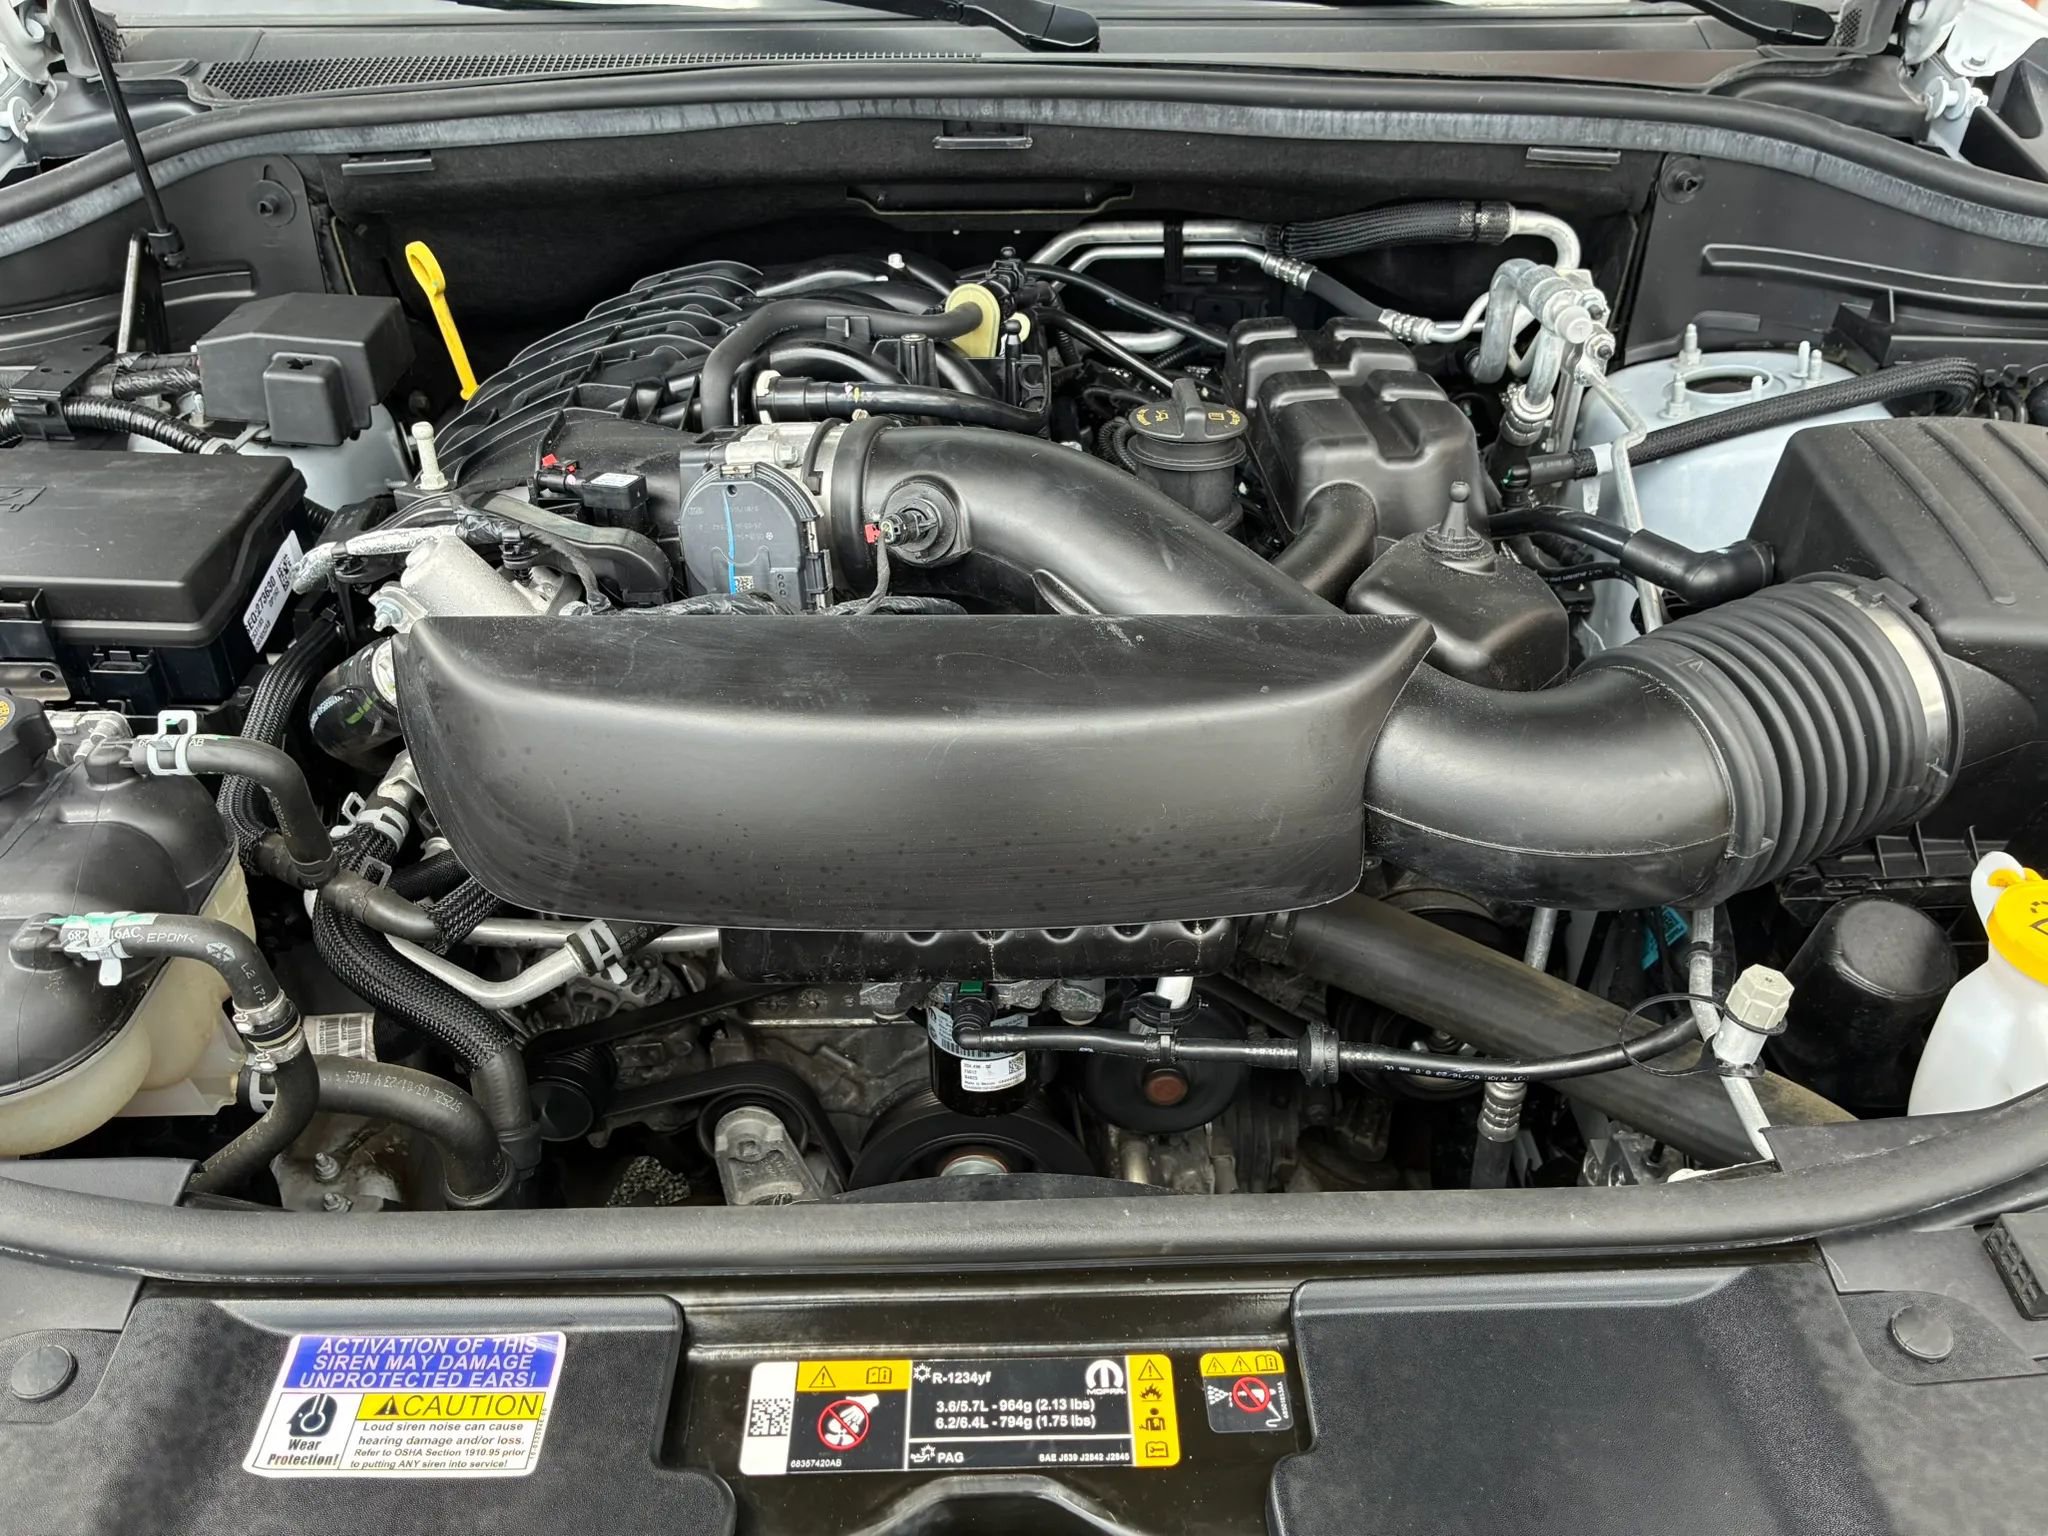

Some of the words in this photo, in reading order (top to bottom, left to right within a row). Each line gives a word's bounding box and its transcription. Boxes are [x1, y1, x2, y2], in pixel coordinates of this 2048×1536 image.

[317, 1337, 449, 1354] ACTIVATION
[455, 1337, 485, 1354] OF
[491, 1335, 539, 1353] THIS
[313, 1355, 379, 1370] SIREN
[385, 1354, 434, 1370] MAY
[438, 1354, 534, 1370] DAMAGE
[299, 1371, 463, 1388] UNPROTECTED
[469, 1370, 537, 1388] EARS!
[932, 1371, 992, 1386] R-1234yf
[403, 1394, 540, 1416] CAUTION
[936, 1400, 989, 1413] 3.6/5.7L
[999, 1400, 1032, 1413] 964g
[1035, 1398, 1067, 1413] (2.13
[1070, 1398, 1096, 1412] lbs)
[363, 1422, 394, 1431] Loud
[396, 1422, 426, 1431] siren
[429, 1421, 461, 1431] noise
[464, 1423, 485, 1431] can
[489, 1423, 524, 1431] cause
[935, 1417, 989, 1430] 6.2/6.4L
[1000, 1416, 1032, 1430] 794g
[1035, 1415, 1068, 1430] (1.75
[1071, 1415, 1097, 1429] lbs)
[288, 1438, 322, 1451] Wear
[358, 1435, 403, 1447] hearing
[406, 1435, 453, 1447] damage
[456, 1435, 495, 1445] and/or
[497, 1435, 525, 1445] loss.
[266, 1453, 340, 1466] Protection!
[354, 1448, 380, 1457] Refer
[382, 1448, 392, 1457] to
[394, 1448, 423, 1457] OSHA
[425, 1448, 461, 1457] Section
[464, 1448, 501, 1457] 1910.95
[502, 1447, 527, 1458] prior
[937, 1452, 964, 1463] PAG
[350, 1460, 360, 1468] to
[361, 1460, 397, 1470] putting
[398, 1459, 420, 1468] ANY
[422, 1459, 446, 1468] siren
[448, 1459, 468, 1468] into
[469, 1459, 508, 1468] service!
